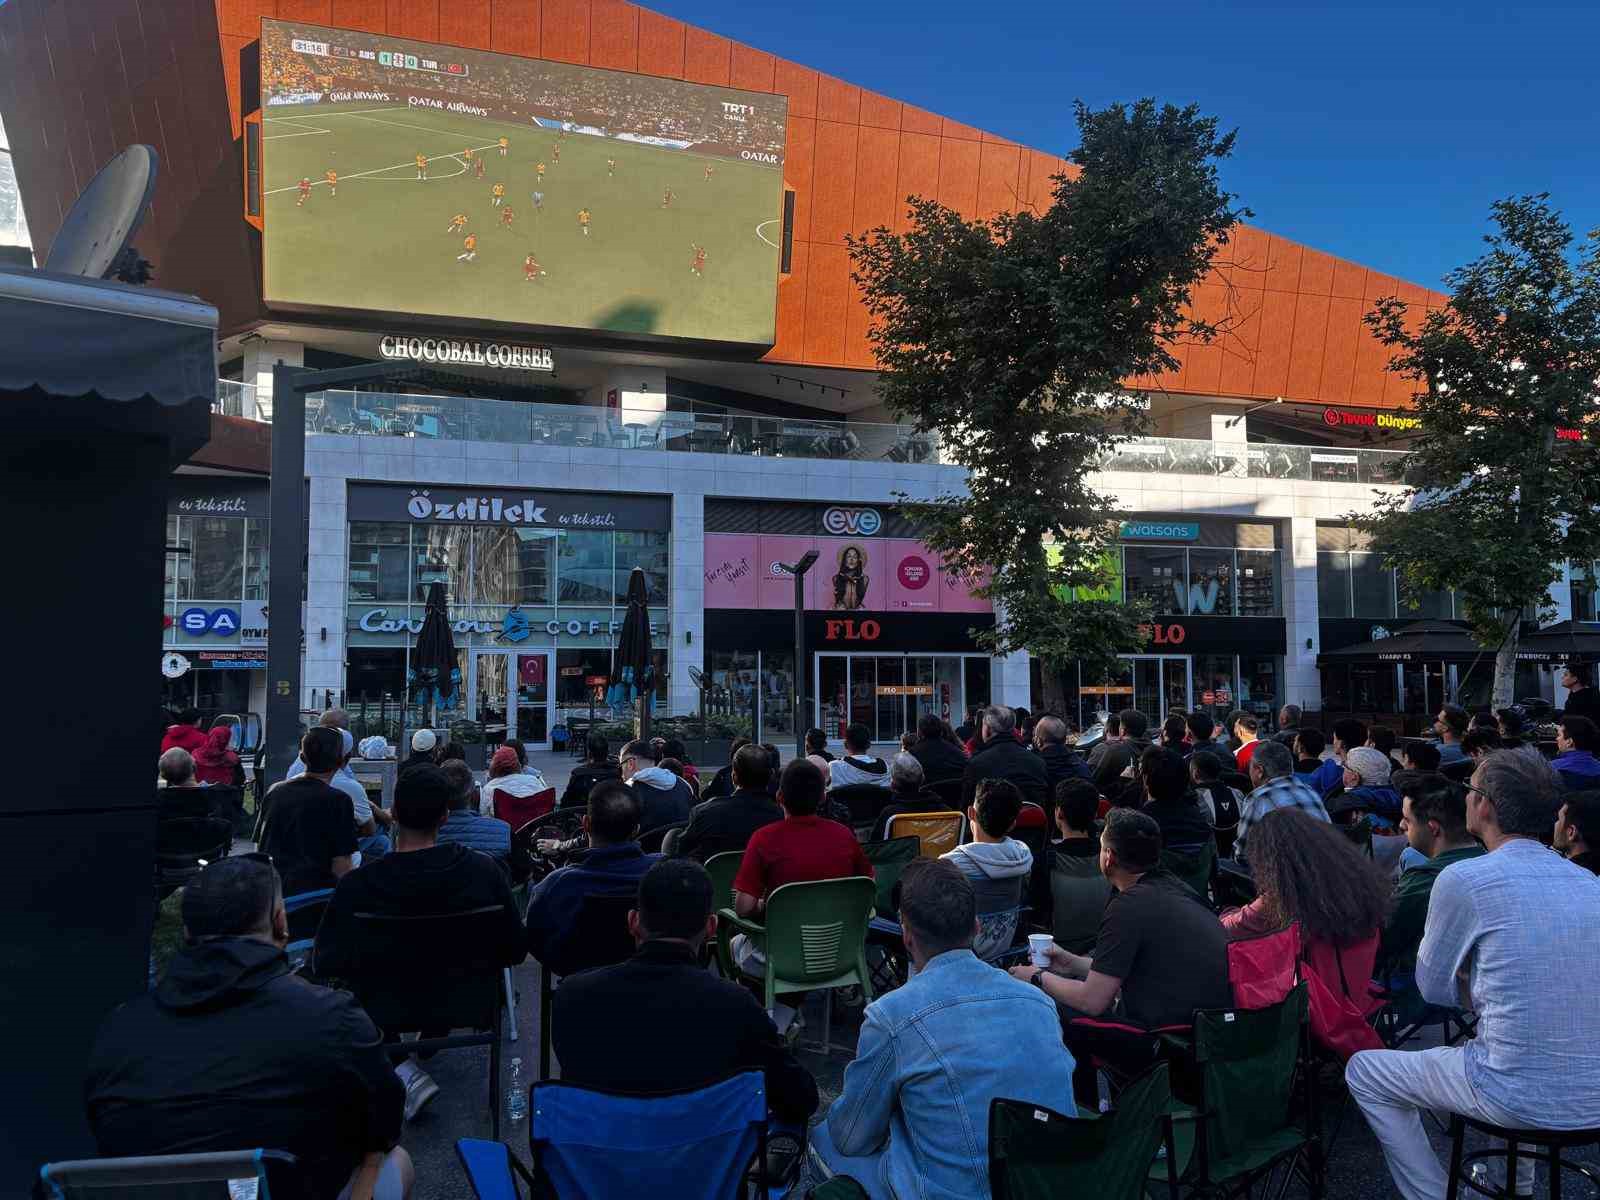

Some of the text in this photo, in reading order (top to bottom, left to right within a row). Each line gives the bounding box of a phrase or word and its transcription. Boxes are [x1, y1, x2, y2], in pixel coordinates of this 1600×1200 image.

[422, 59, 438, 70] TUR
[329, 92, 352, 102] QATAR
[353, 91, 390, 101] AIRWAYS
[408, 96, 488, 117] QATAR AIRWAYS
[741, 150, 778, 164] QATAR
[379, 335, 555, 372] CHOCOBAL COFFEE
[179, 497, 248, 512] ev tekstili
[408, 489, 548, 523] Özdilek
[558, 511, 616, 526] ev tekstili
[824, 508, 881, 534] eve
[1128, 523, 1189, 537] watsons
[185, 614, 235, 629] SA
[359, 608, 660, 637] Cariou COFFE
[824, 619, 881, 641] FLO
